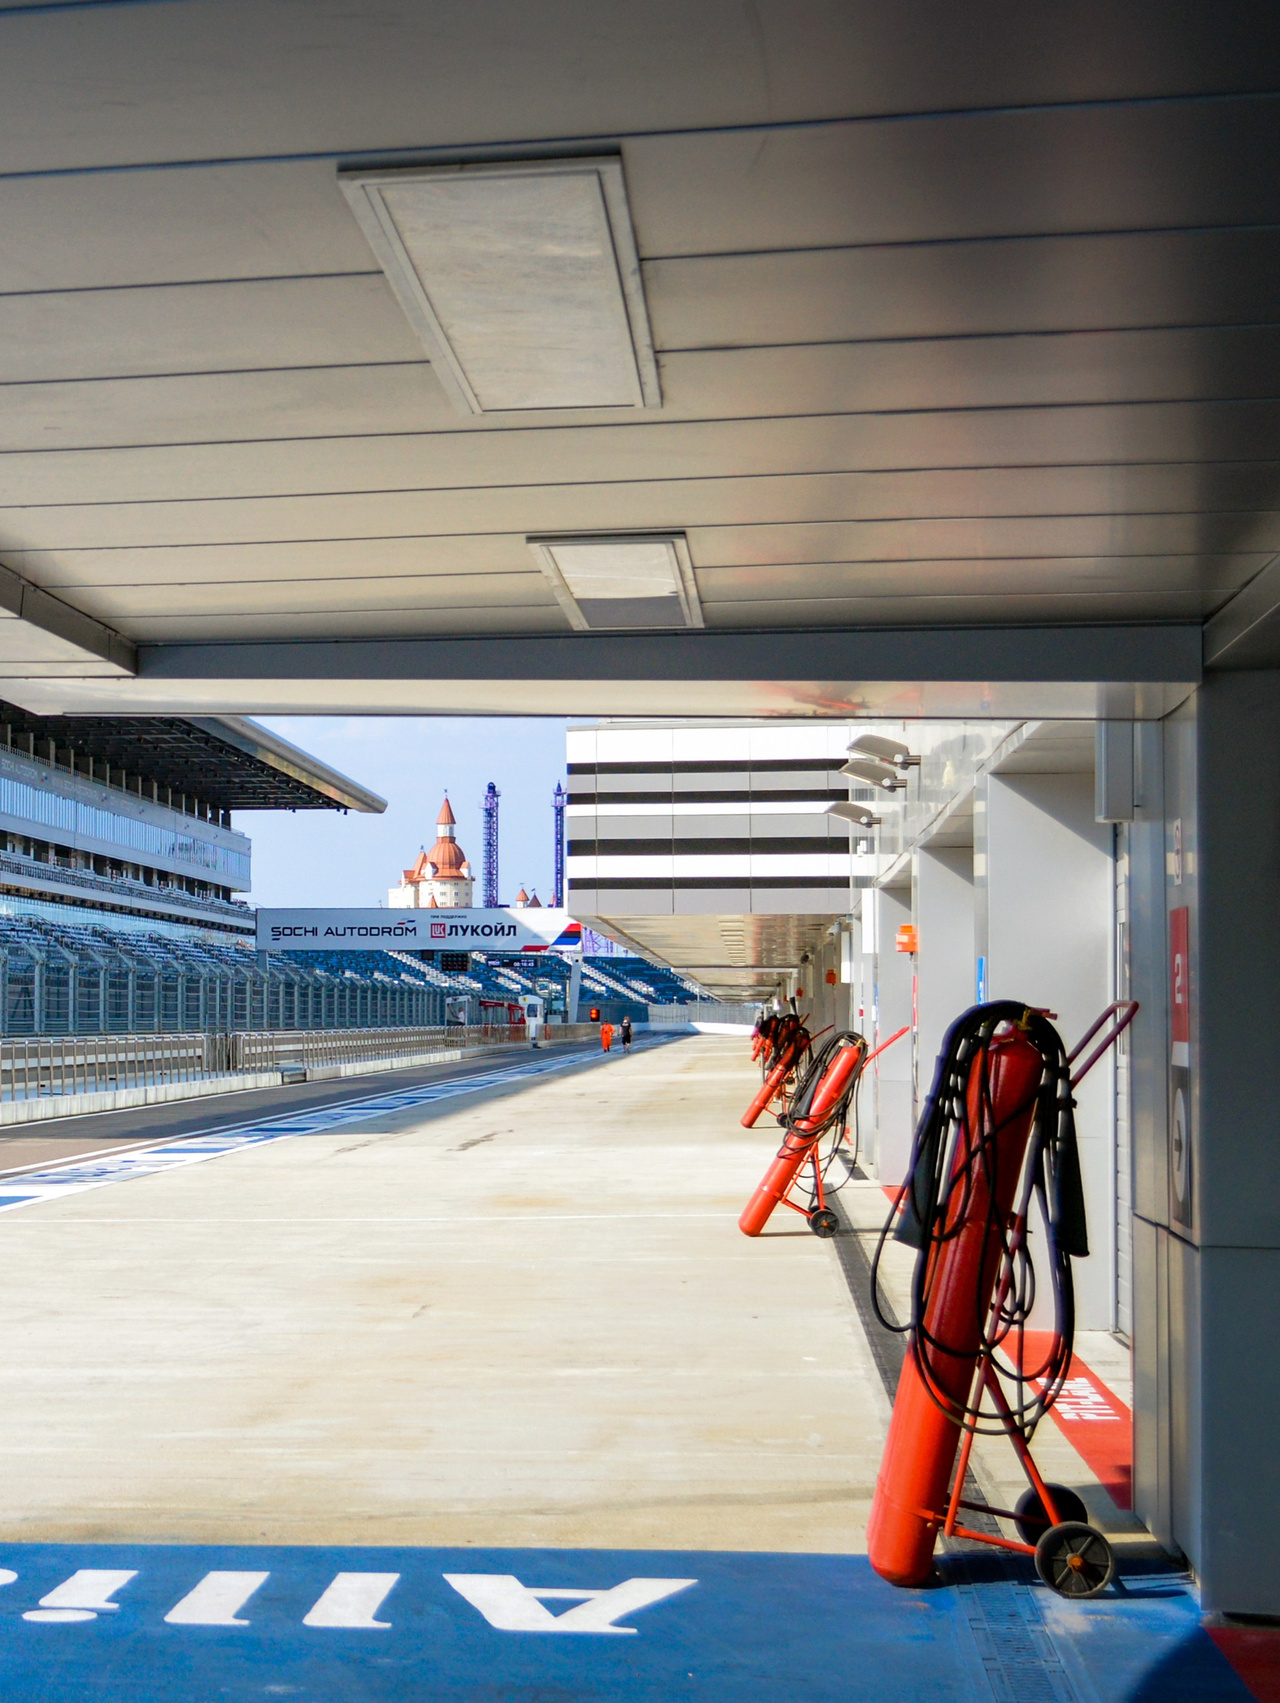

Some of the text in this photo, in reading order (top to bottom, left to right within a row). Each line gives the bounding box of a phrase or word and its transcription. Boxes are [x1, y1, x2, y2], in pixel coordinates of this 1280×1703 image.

[271, 926, 417, 938] SOCHI AUTODROM
[447, 922, 517, 937] ЛУКОЙЛ
[1175, 953, 1183, 1004] 2
